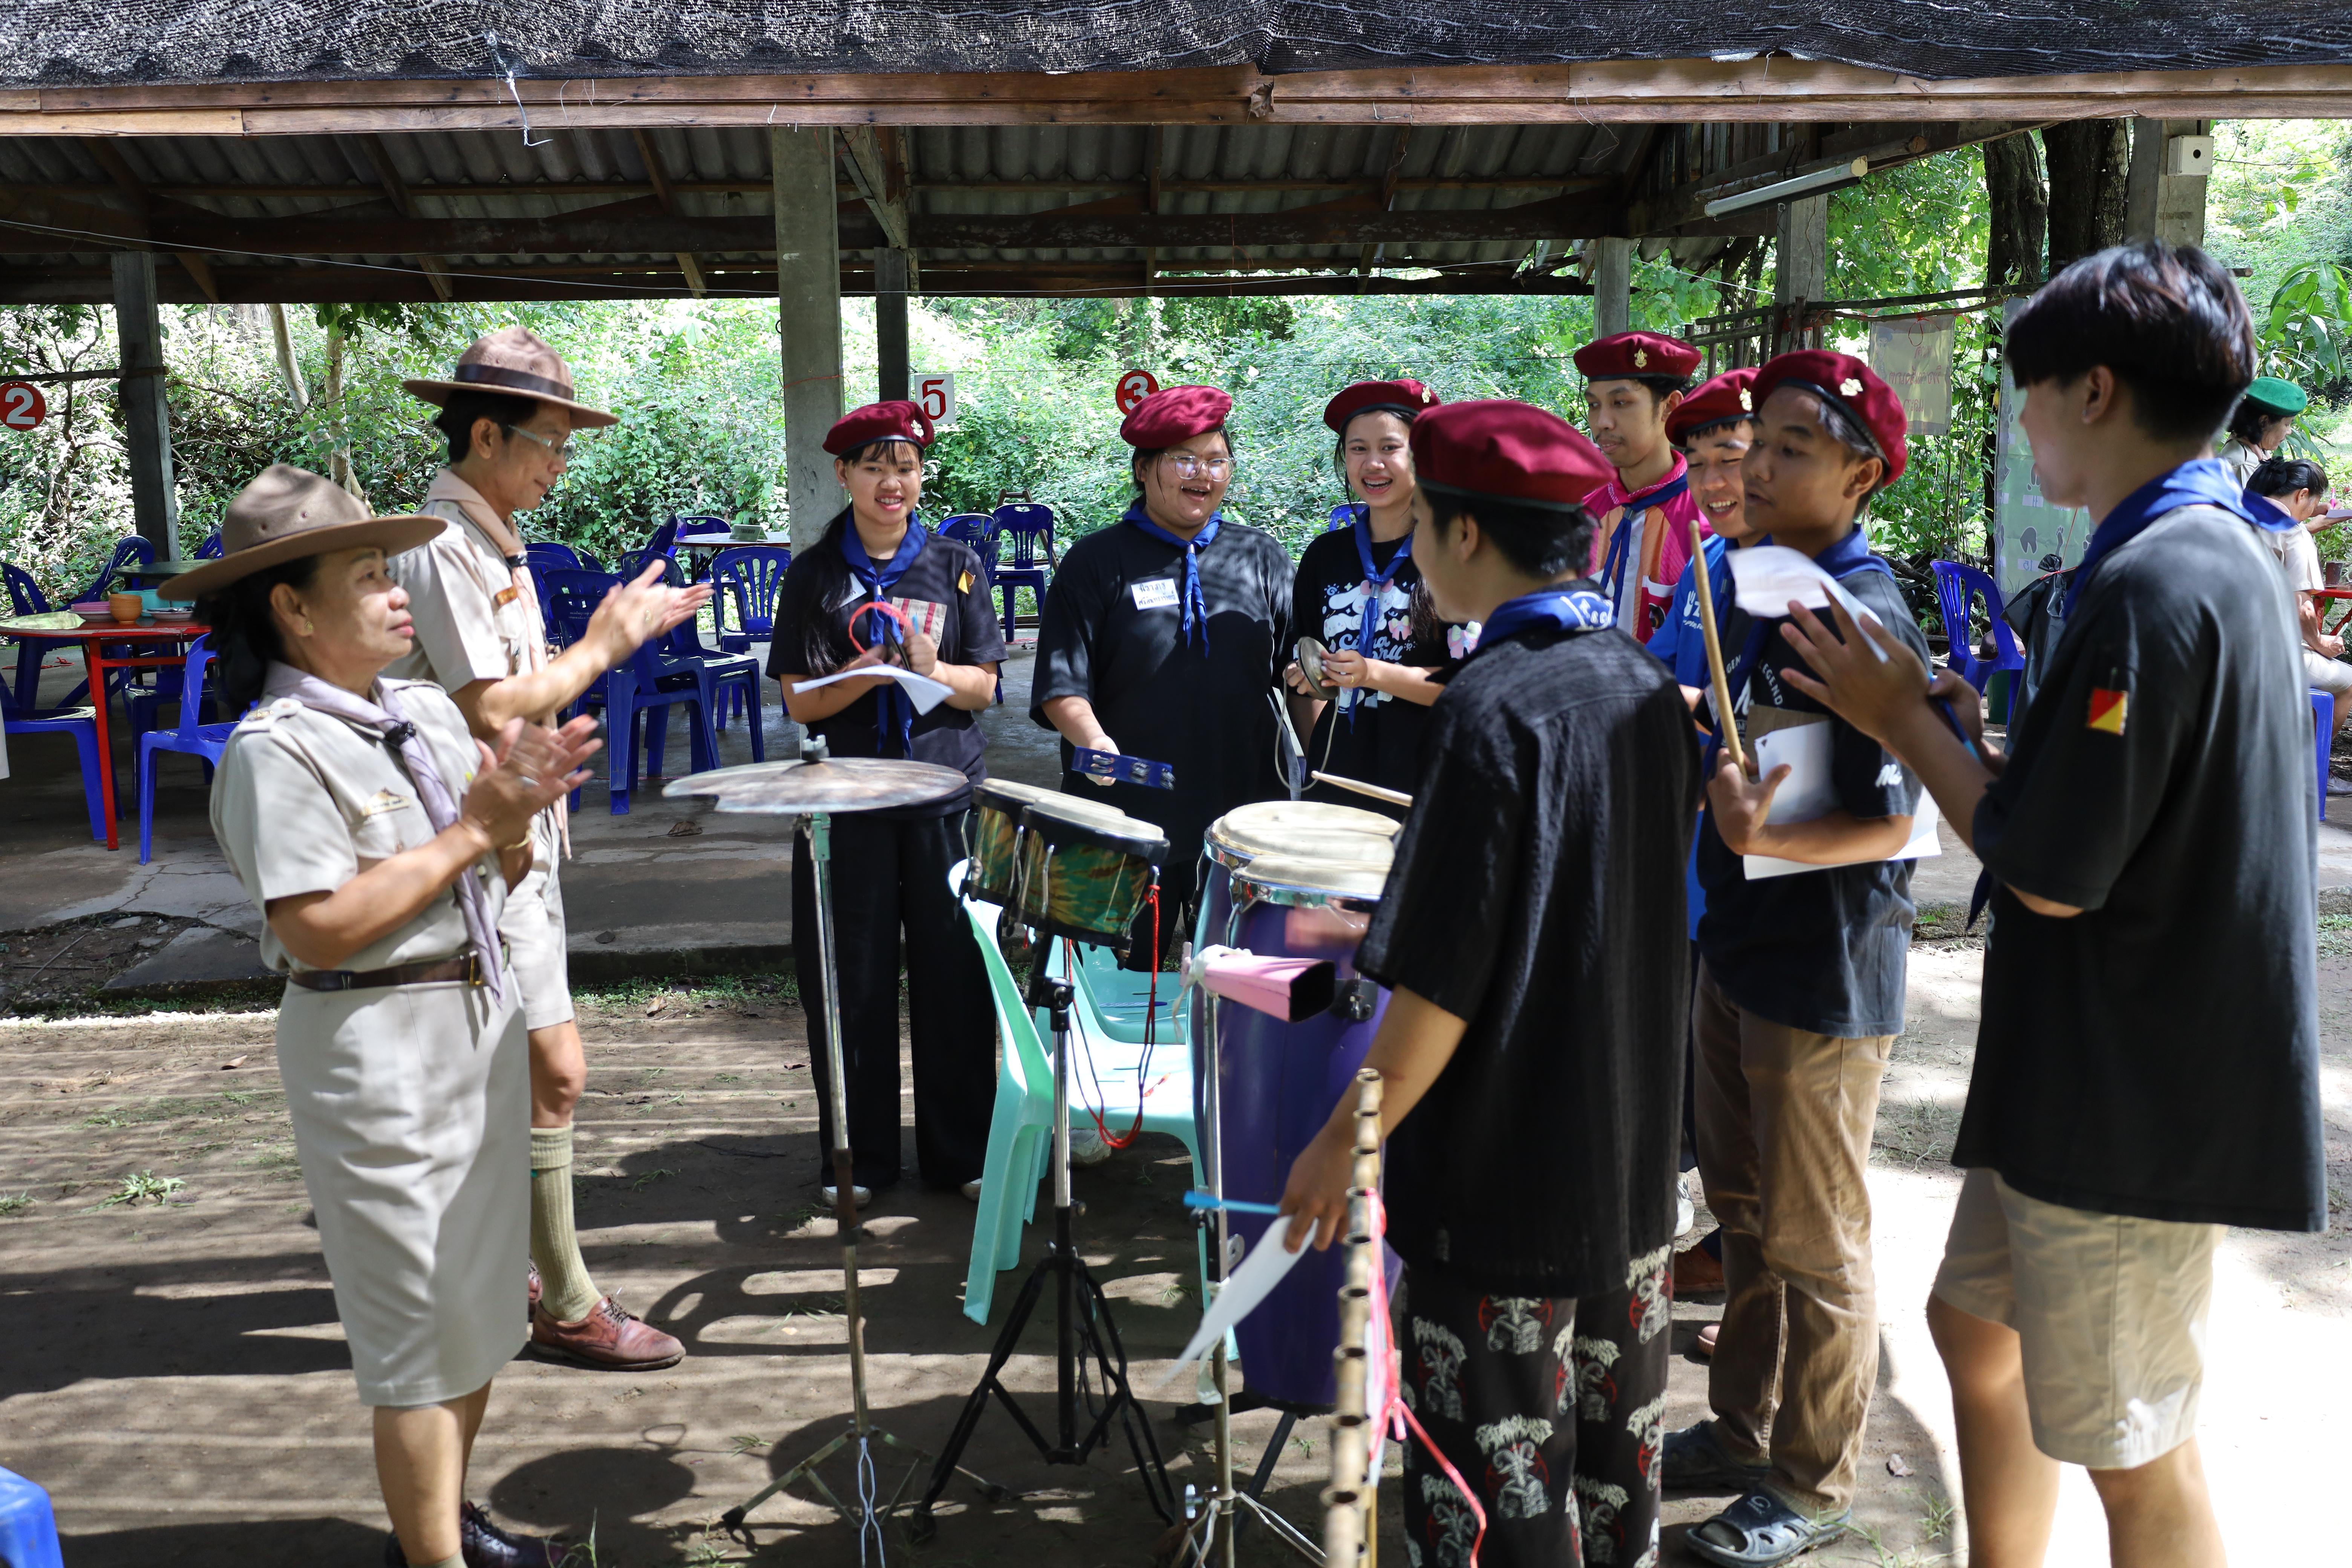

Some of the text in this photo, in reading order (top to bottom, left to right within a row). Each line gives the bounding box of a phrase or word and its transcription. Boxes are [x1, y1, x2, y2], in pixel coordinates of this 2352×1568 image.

[5, 387, 36, 425] 2
[922, 379, 946, 420] 5
[1124, 375, 1150, 410] 3
